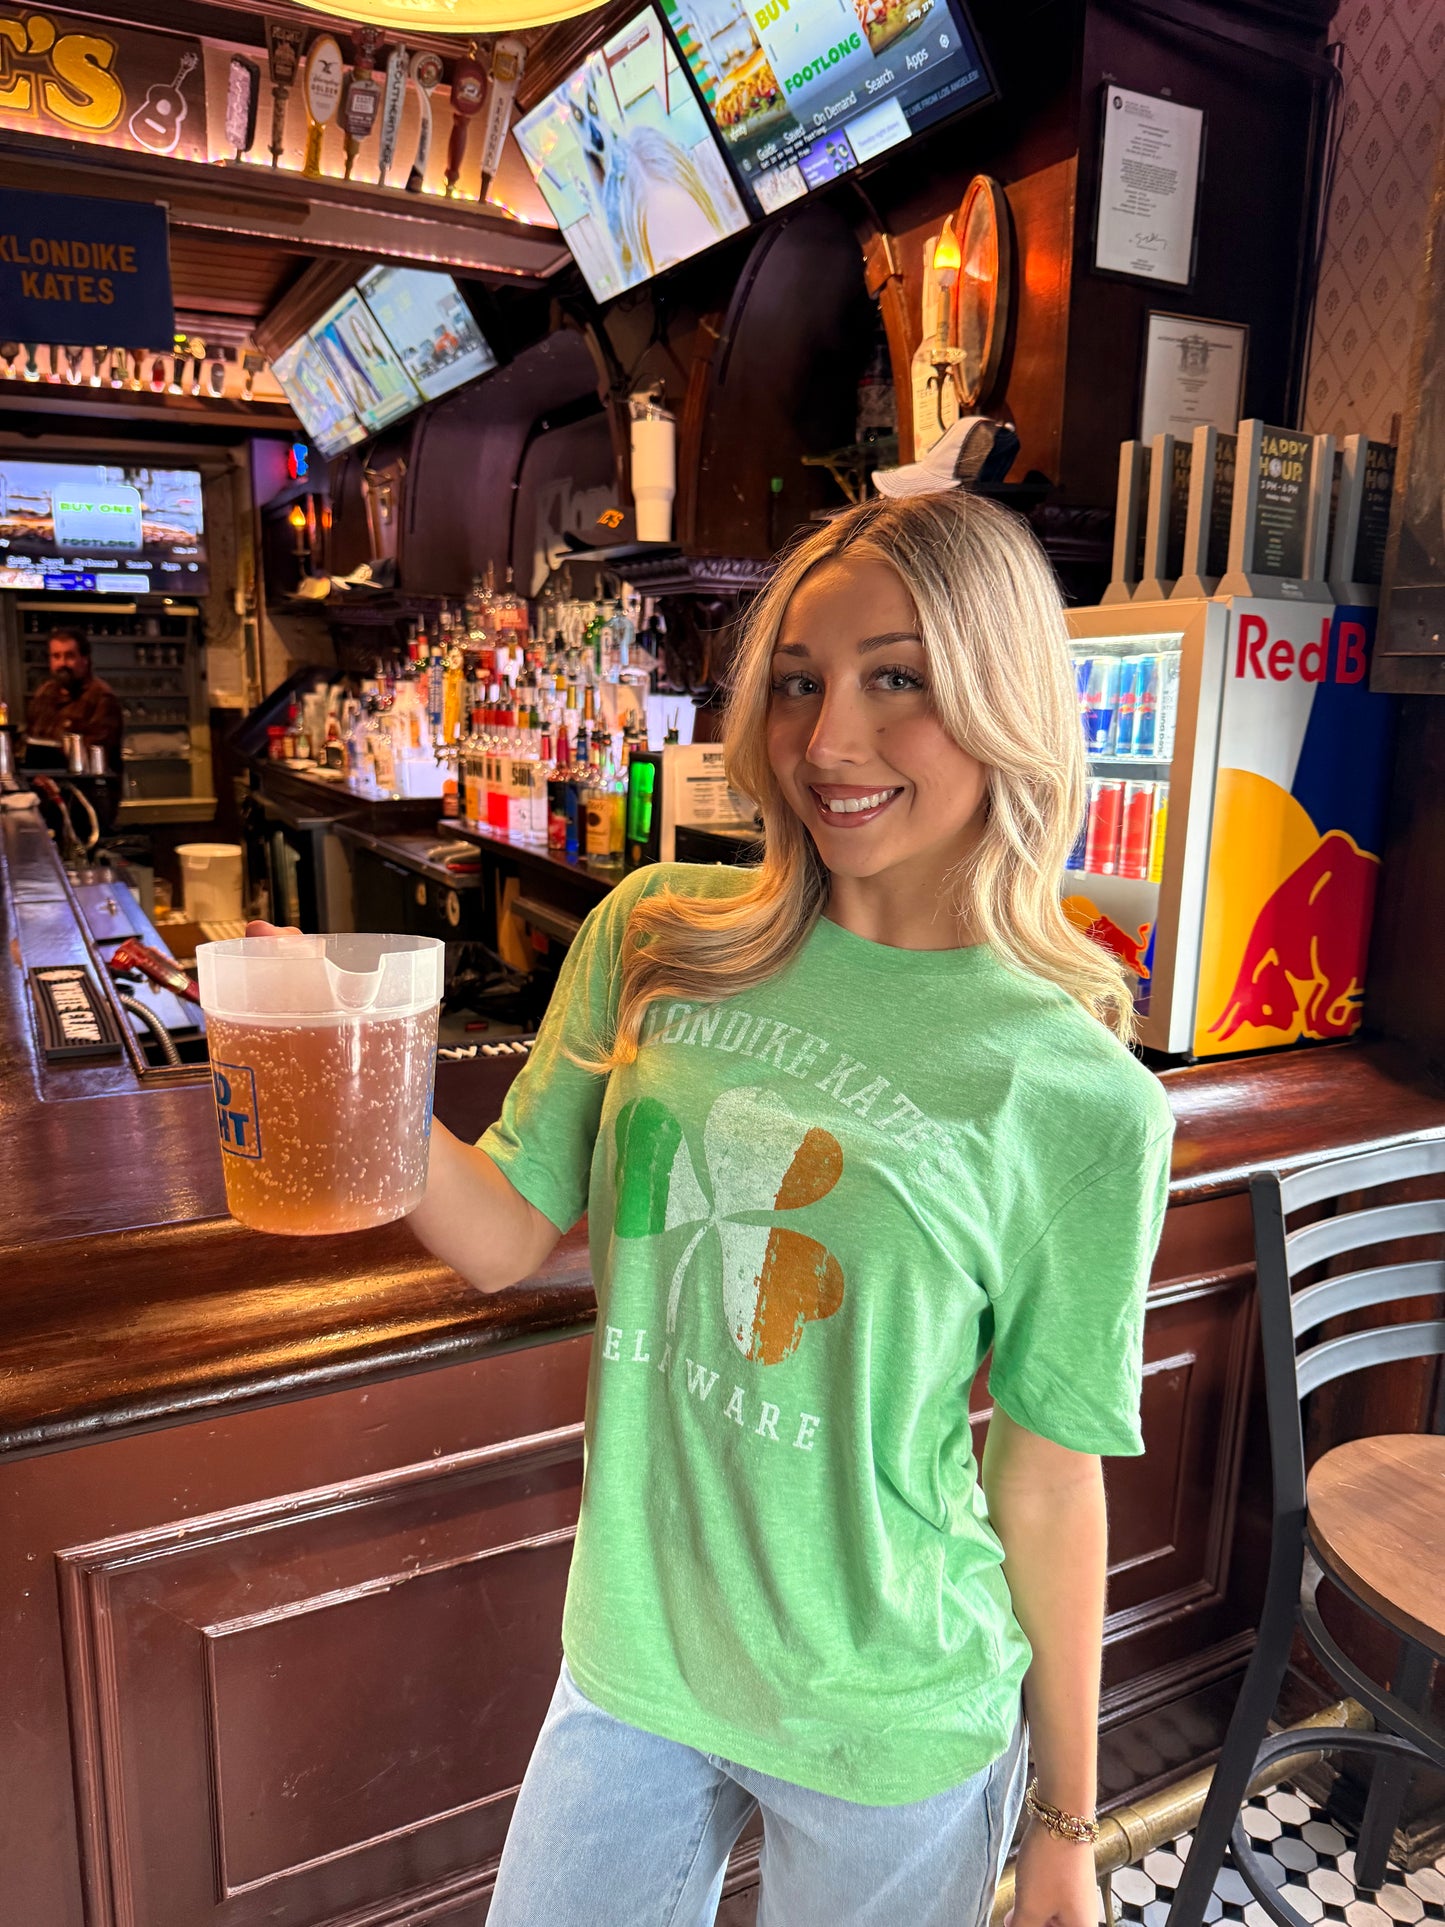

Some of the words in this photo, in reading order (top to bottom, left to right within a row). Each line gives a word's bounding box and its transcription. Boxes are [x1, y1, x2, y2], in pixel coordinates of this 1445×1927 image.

[784, 32, 861, 95] FOOTLONG
[757, 143, 778, 161] Guide
[813, 111, 826, 126] On
[824, 90, 857, 120] Demand
[865, 68, 895, 94] Search
[905, 48, 929, 71] Apps
[21, 271, 115, 305] KATES
[1259, 456, 1304, 482] HOUR
[1260, 435, 1309, 461] HAPPY
[60, 502, 93, 513] BUY
[100, 504, 133, 514] ONE
[1235, 614, 1331, 683] Red
[644, 1003, 830, 1080] LONDIKE
[602, 1324, 821, 1451] ELAWARE
